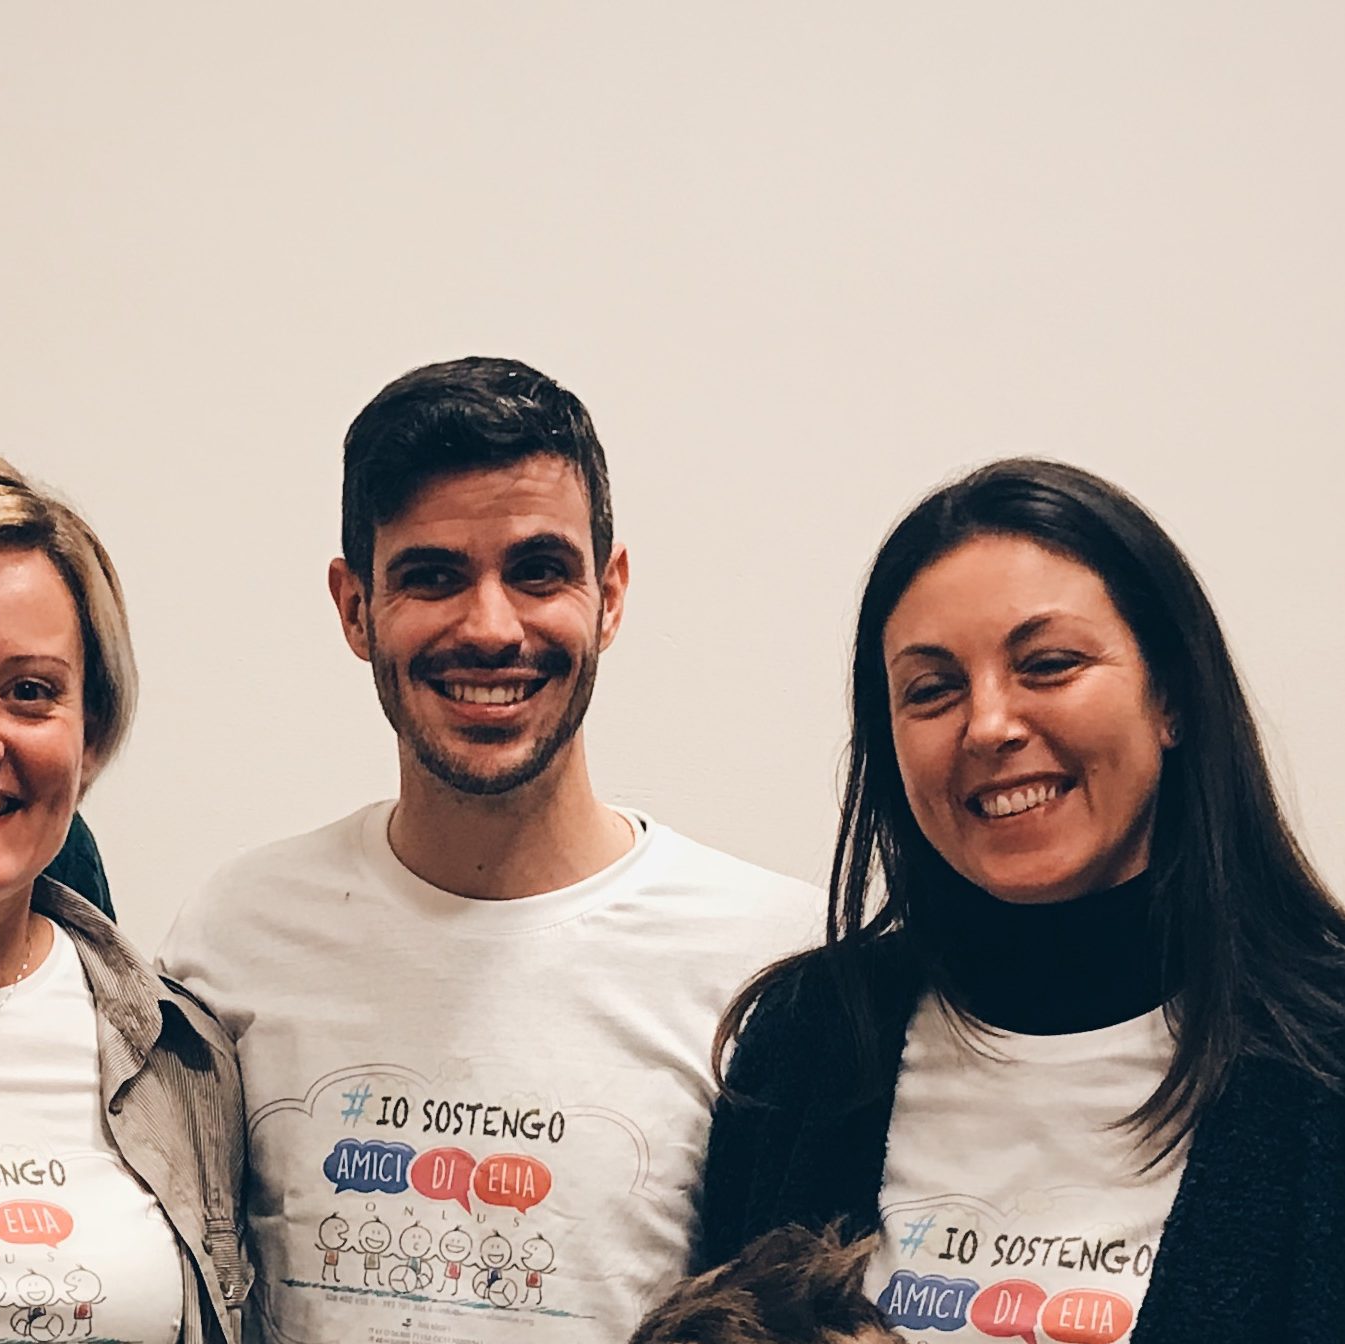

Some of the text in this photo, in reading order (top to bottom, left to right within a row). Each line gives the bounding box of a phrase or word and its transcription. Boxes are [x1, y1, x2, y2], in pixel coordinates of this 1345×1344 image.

[422, 1098, 565, 1143] SOSTENGO
[336, 1148, 535, 1199] AMICI DI ELIA
[3, 1208, 61, 1235] ELIA
[365, 1202, 520, 1227] ONLUS
[990, 1234, 1153, 1277] SOSTENGO
[888, 1281, 1114, 1335] AMICI DI ELIA
